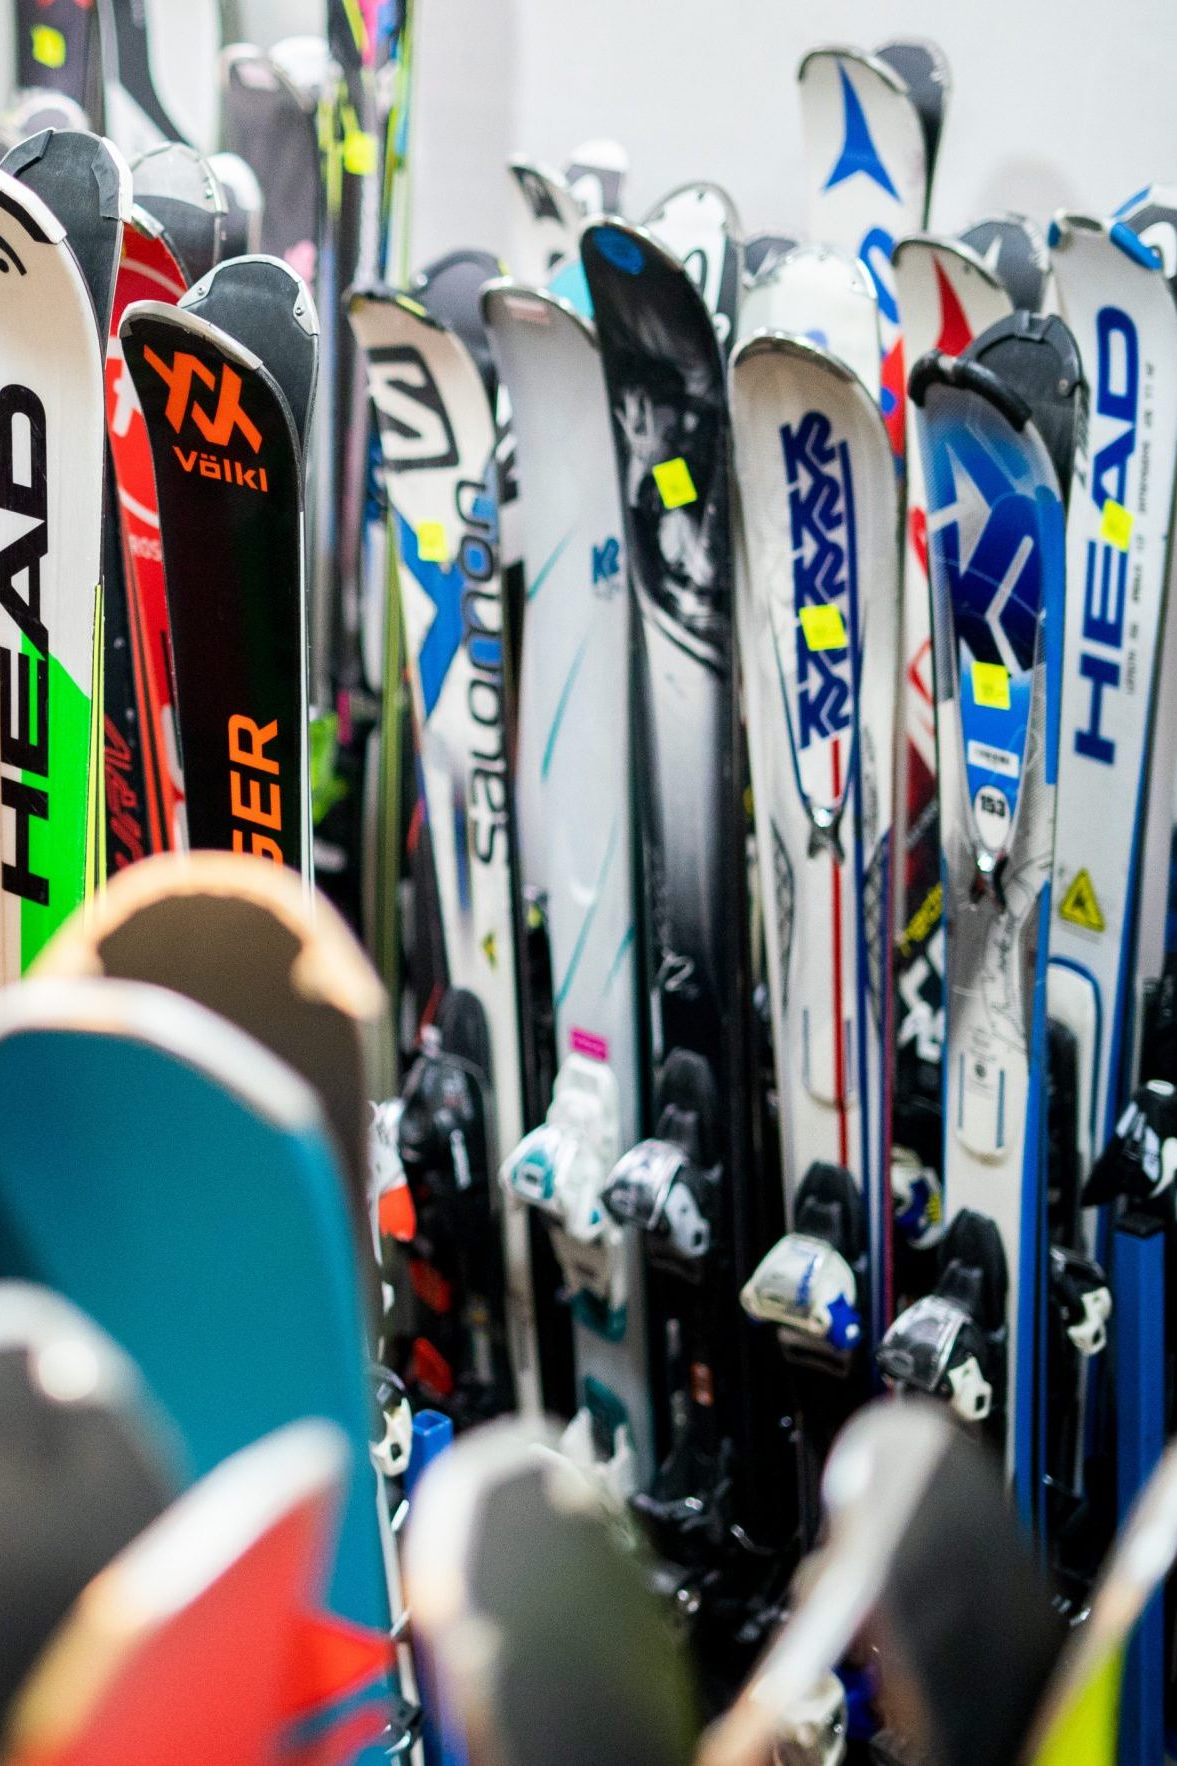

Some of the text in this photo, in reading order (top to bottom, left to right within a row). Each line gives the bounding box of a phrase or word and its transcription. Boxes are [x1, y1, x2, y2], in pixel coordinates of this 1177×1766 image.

[172, 445, 269, 493] Völkl
[1074, 305, 1139, 766] HEAD
[981, 796, 1006, 818] 153
